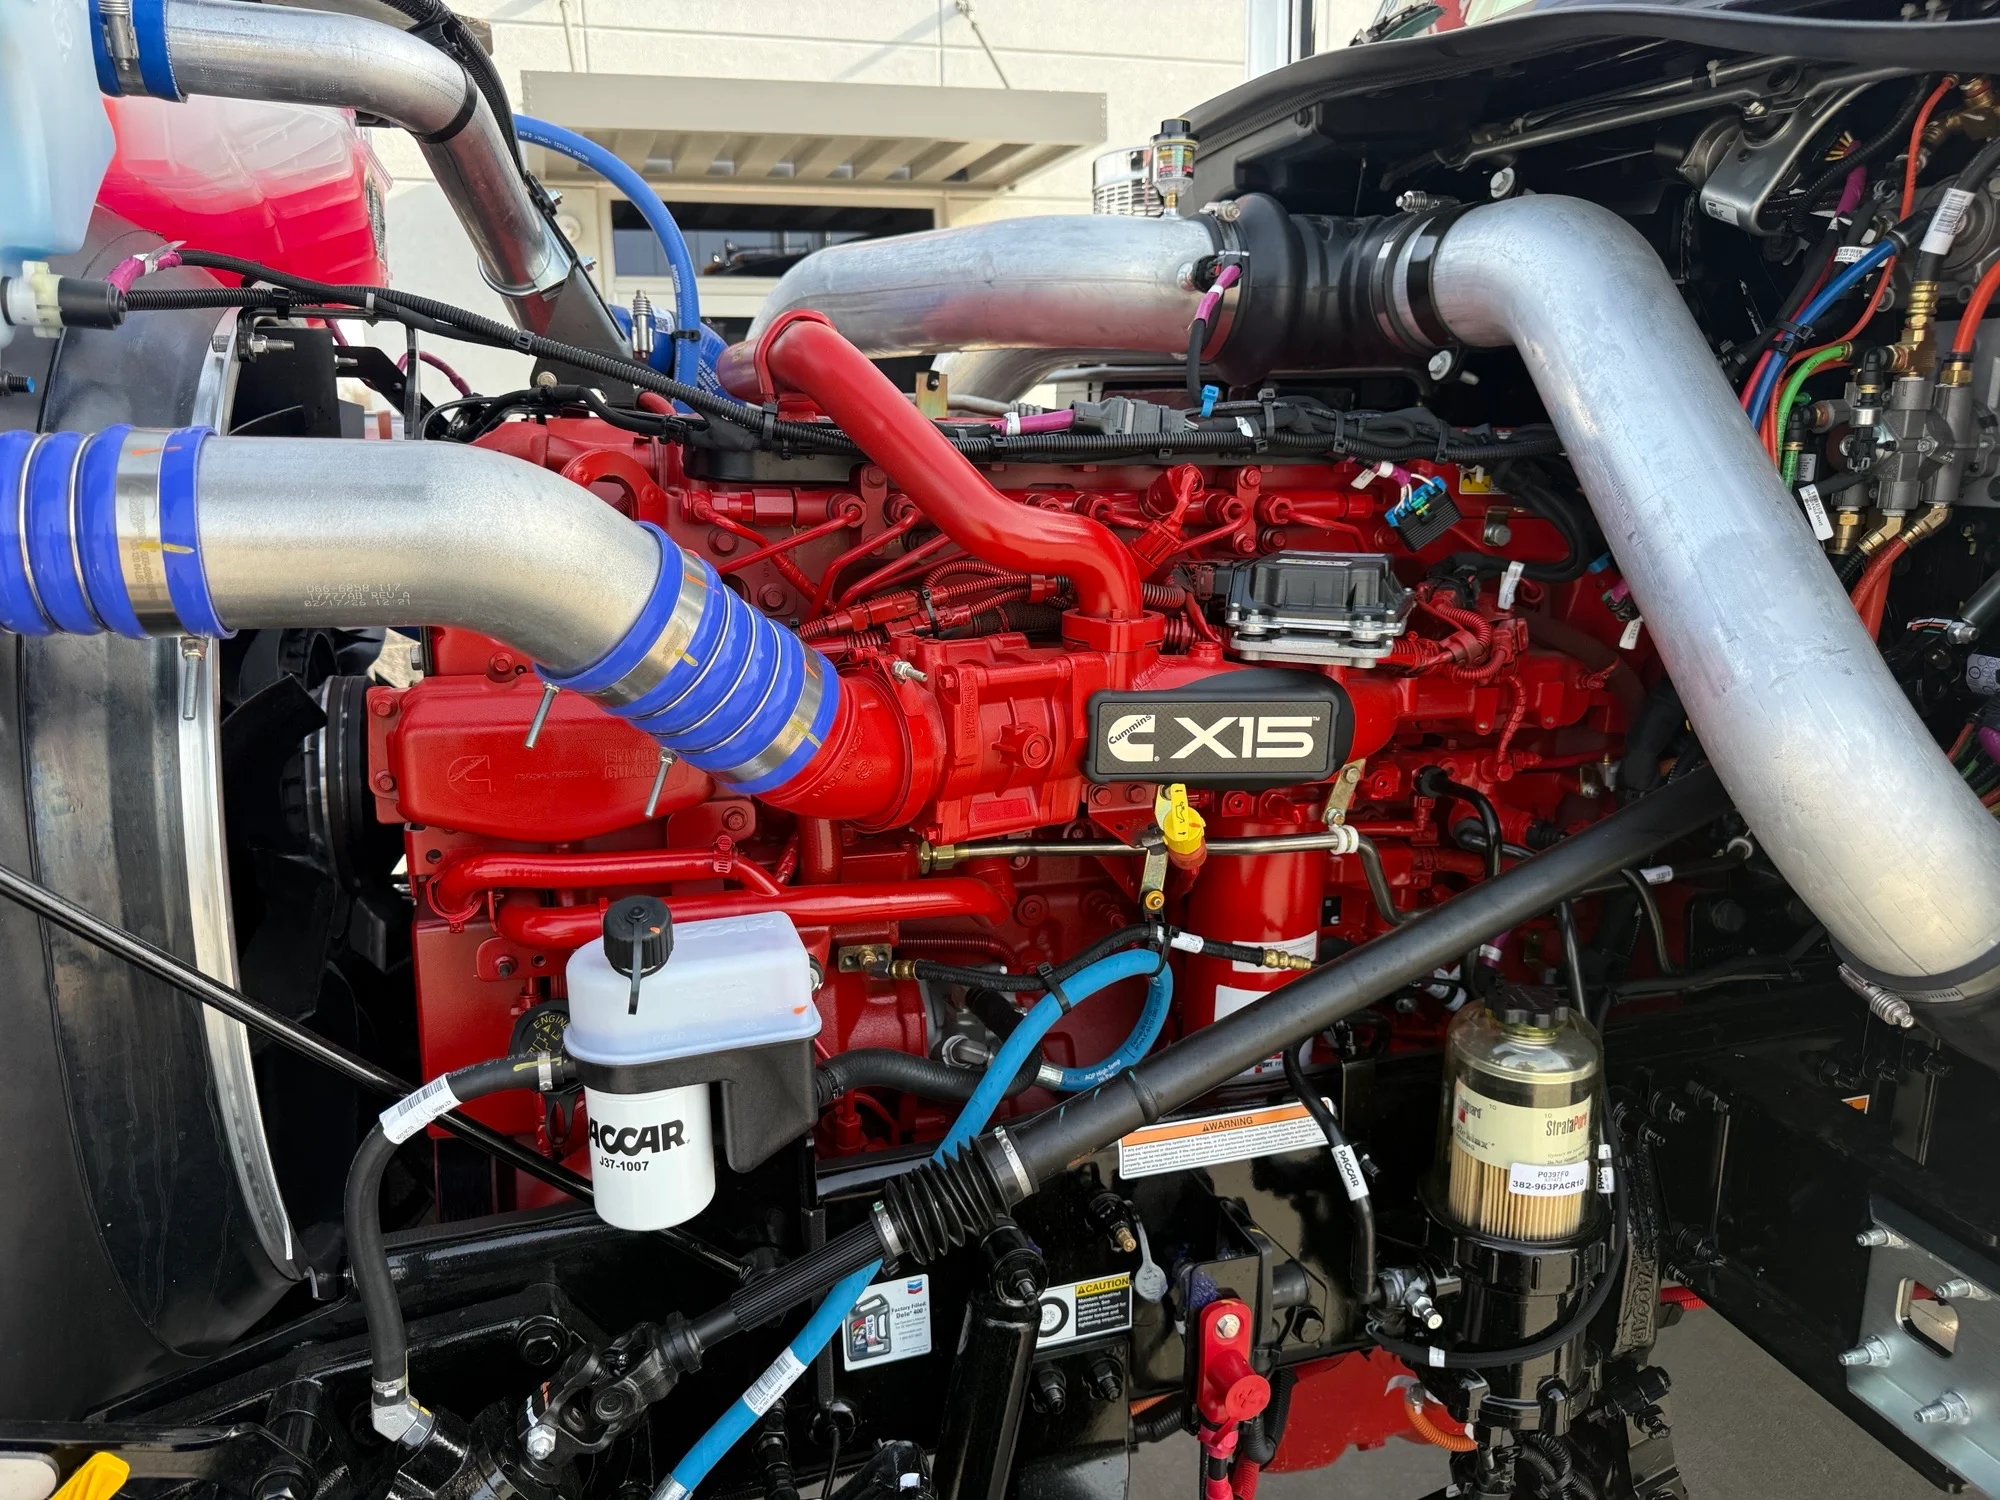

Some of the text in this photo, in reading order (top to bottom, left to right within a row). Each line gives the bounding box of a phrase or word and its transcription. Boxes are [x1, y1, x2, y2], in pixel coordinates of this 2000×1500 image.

[371, 591, 394, 599] REV
[402, 591, 410, 599] A
[1108, 714, 1152, 745] Cummins
[1208, 1116, 1254, 1131] WARNING
[1545, 1111, 1588, 1137] StrataPor
[590, 1116, 686, 1156] ACCAR
[599, 1156, 650, 1171] J37-1007
[1338, 1150, 1359, 1187] PACCAR
[1537, 1170, 1570, 1178] P0397F0
[1512, 1178, 1585, 1191] 382-963PACR10
[1085, 1277, 1128, 1293] CAUTION
[1077, 1295, 1098, 1303] Maintain
[1101, 1302, 1119, 1310] manual
